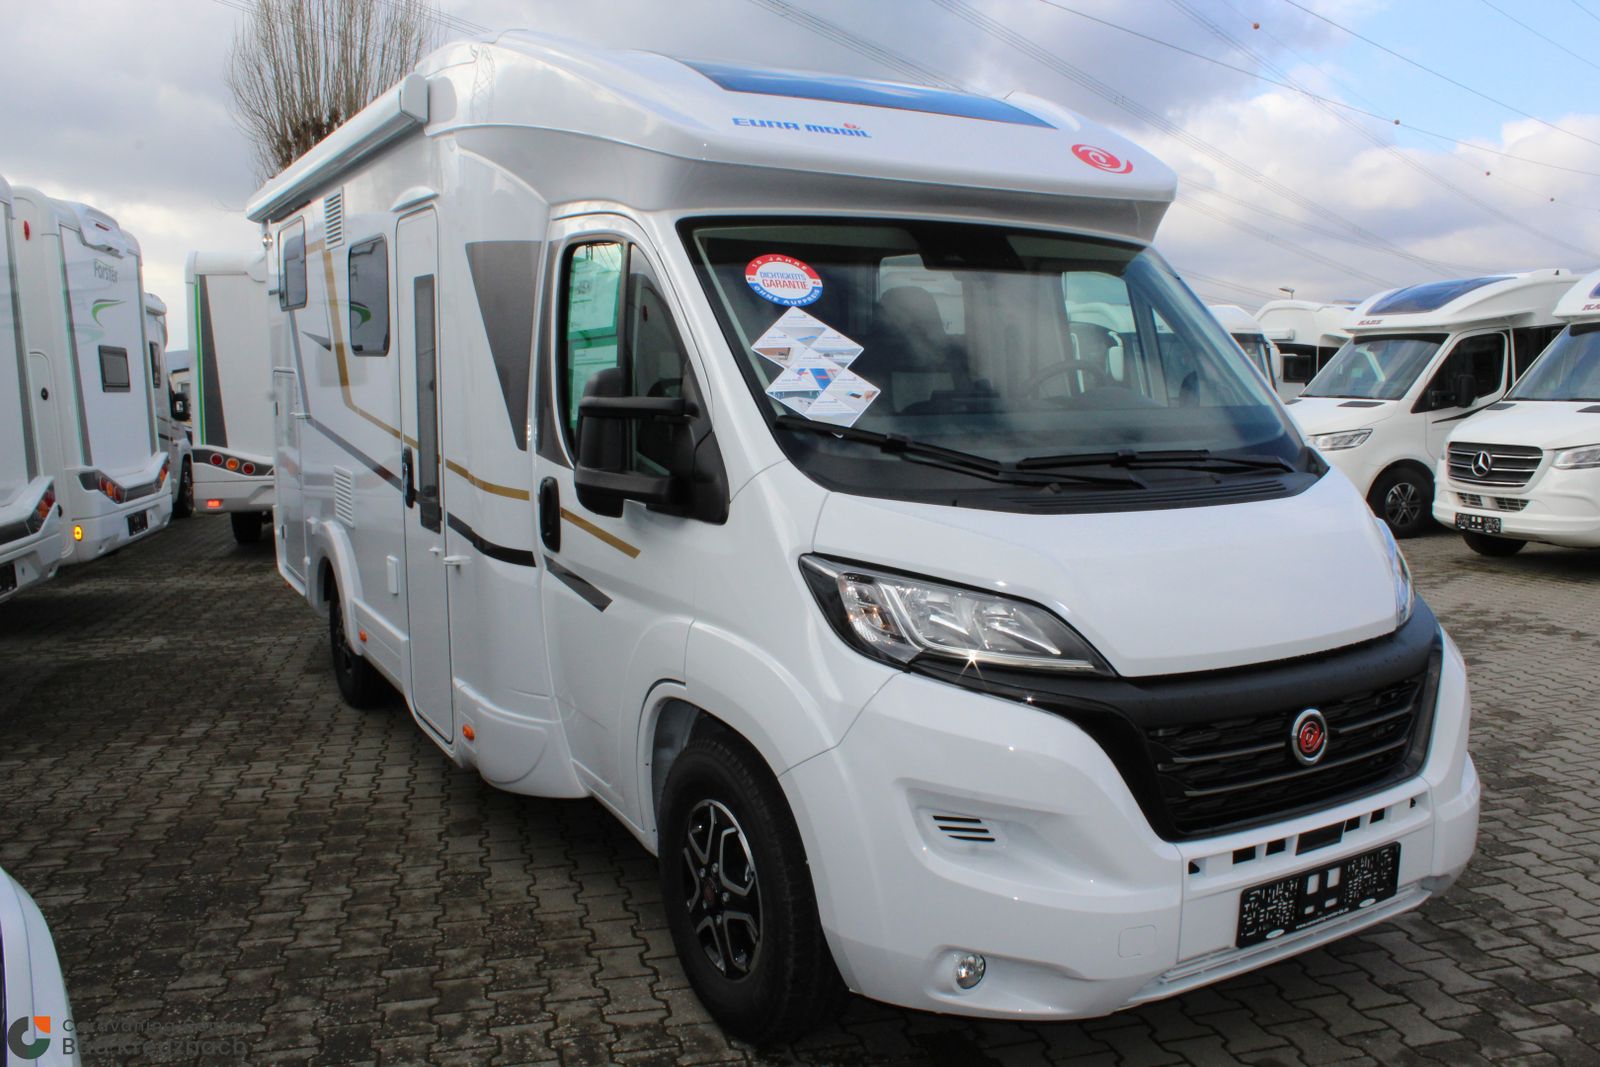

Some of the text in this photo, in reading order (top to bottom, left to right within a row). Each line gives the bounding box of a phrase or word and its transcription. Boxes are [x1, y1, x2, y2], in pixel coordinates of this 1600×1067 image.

[732, 117, 872, 138] EURA MOBIL
[768, 256, 808, 271] JAHRE
[762, 279, 809, 290] GARANTIE
[754, 286, 820, 306] OHNE AUFPREIS
